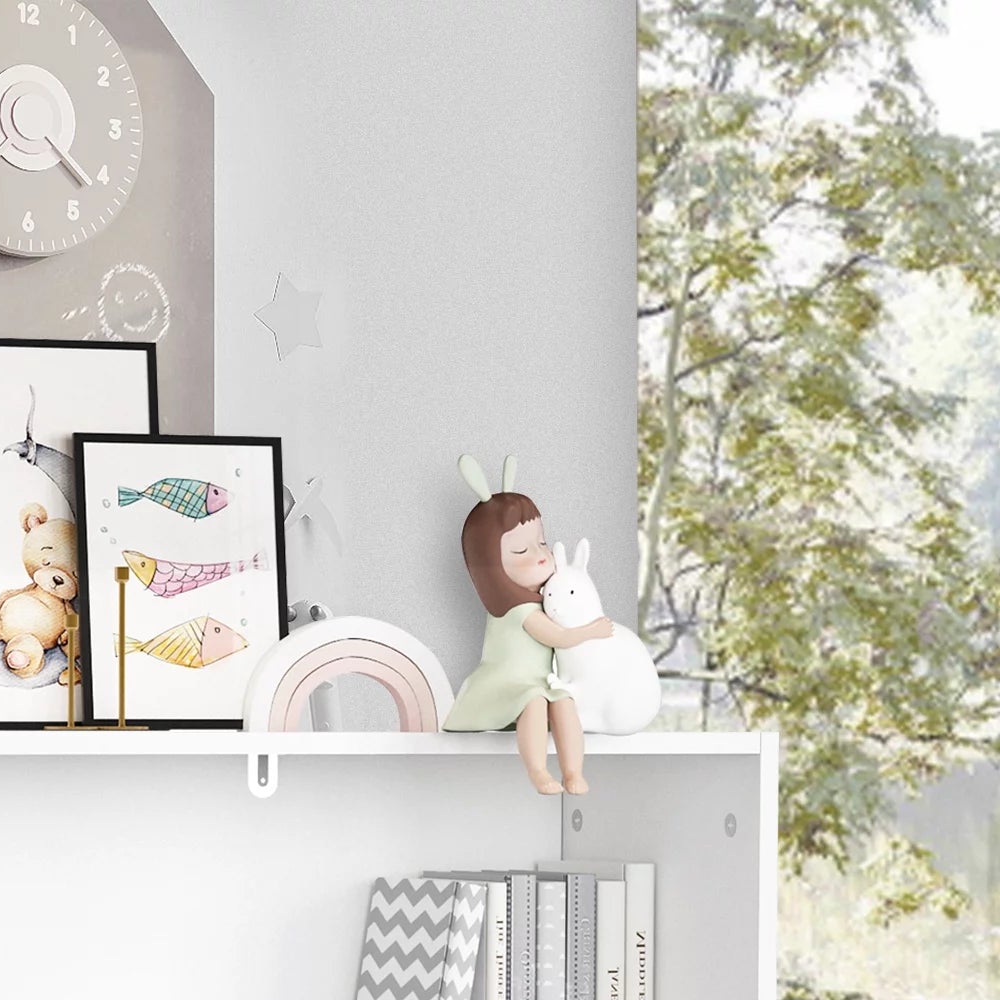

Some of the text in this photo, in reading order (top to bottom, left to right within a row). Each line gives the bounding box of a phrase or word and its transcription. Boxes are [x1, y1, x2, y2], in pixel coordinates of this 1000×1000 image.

[17, 2, 40, 26] 12
[67, 25, 77, 46] 1
[97, 66, 110, 88] 2
[108, 118, 122, 141] 3
[96, 164, 110, 186] 4
[22, 210, 35, 233] 6
[67, 200, 80, 221] 5
